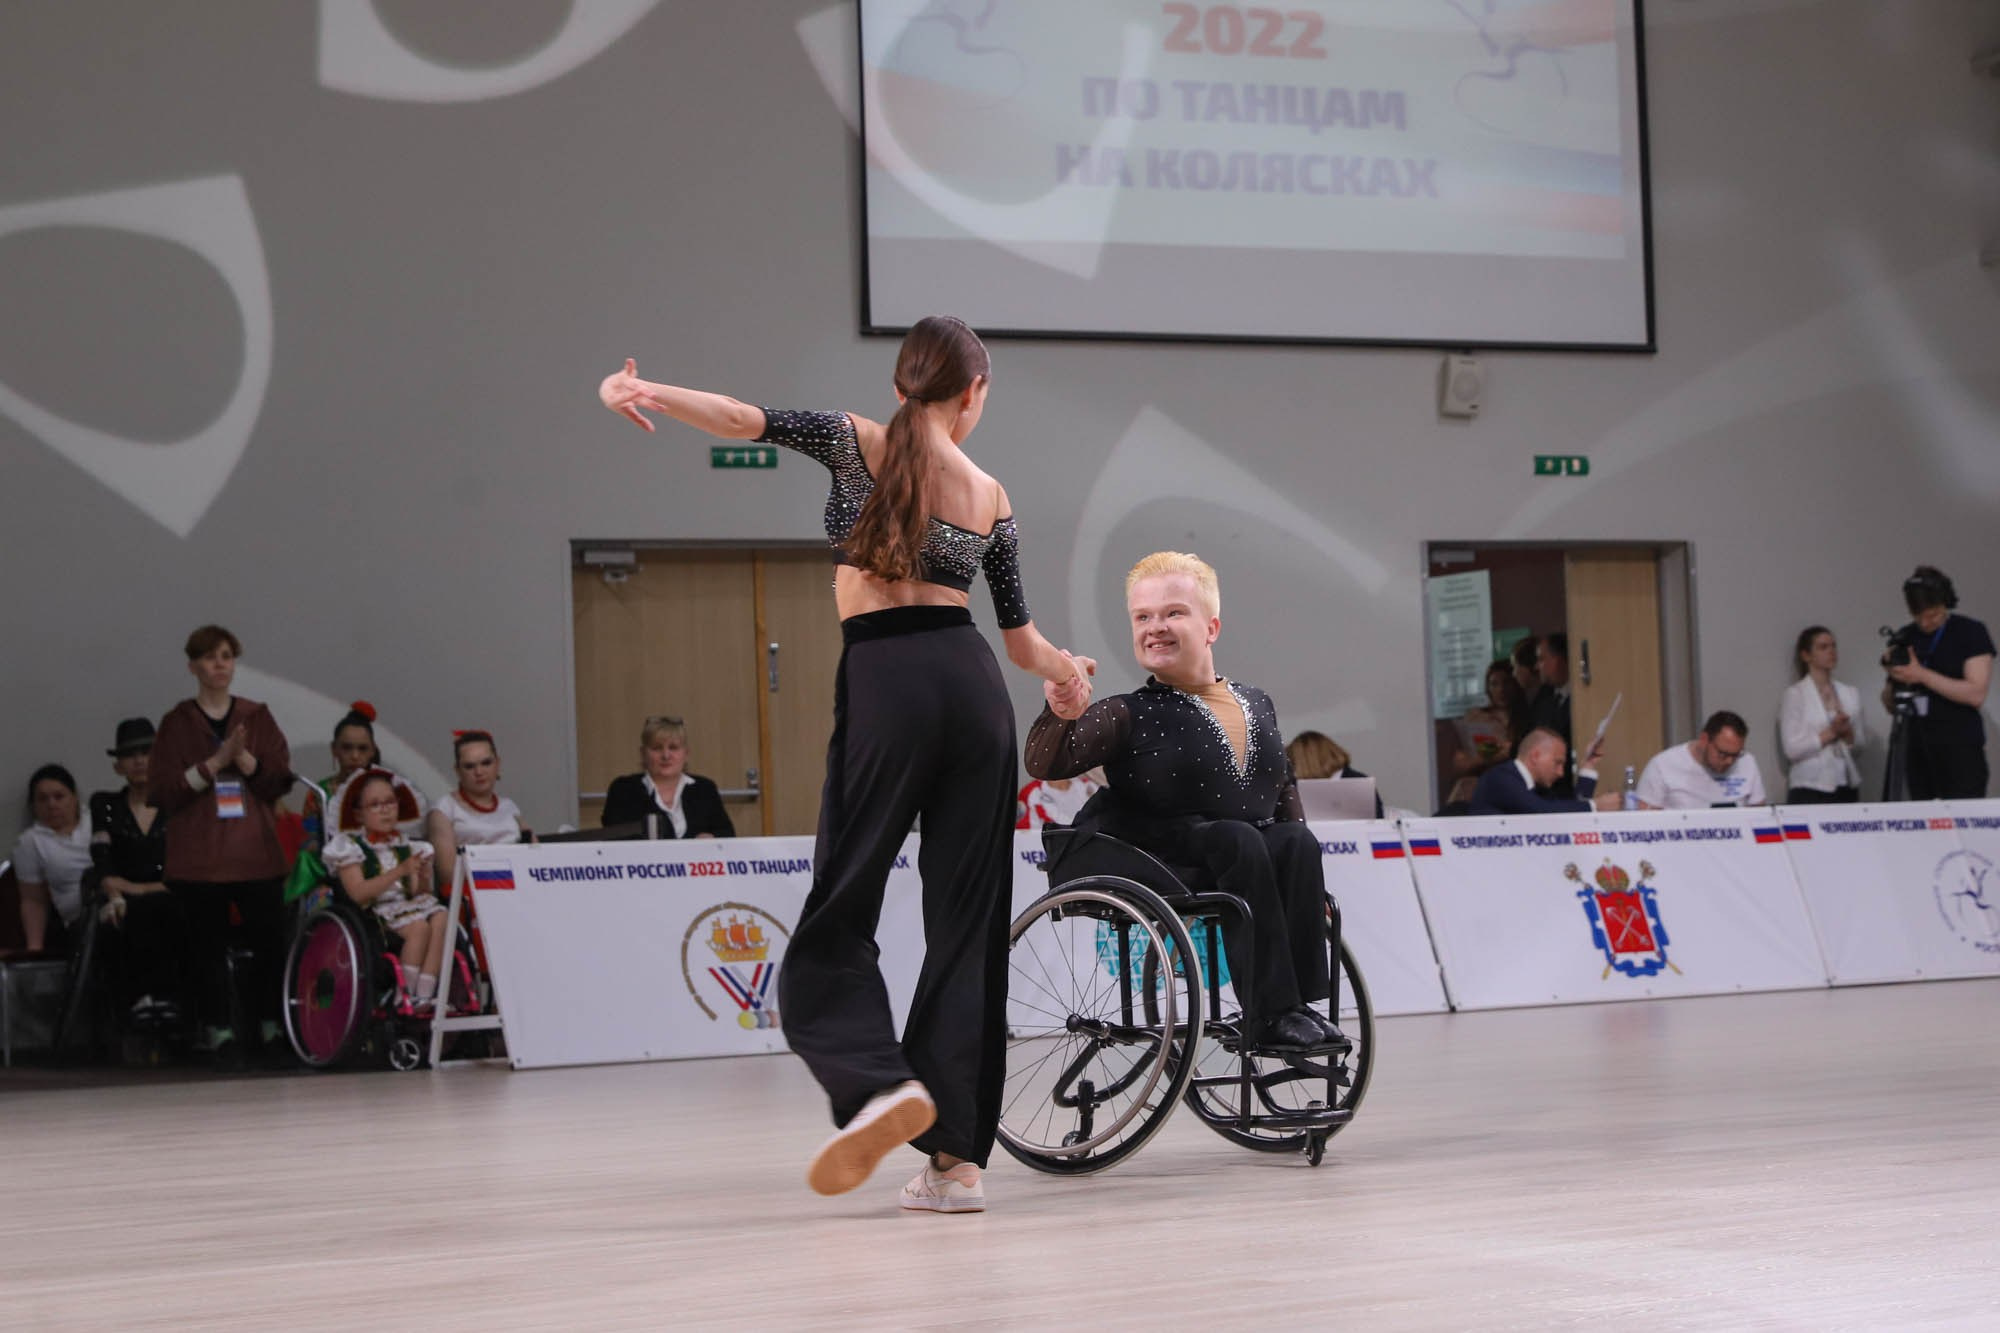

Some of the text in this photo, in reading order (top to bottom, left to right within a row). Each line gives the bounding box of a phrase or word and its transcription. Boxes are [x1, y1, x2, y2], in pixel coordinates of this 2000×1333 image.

[1162, 3, 1328, 60] 2022
[1082, 76, 1407, 135] ПО ТАНЦАМ
[1055, 143, 1438, 198] НА КОЛЯСКАХ
[1451, 827, 1742, 849] ЧЕМПИОНАТ РОССИИ 2022 ПО ТАНЦАМ НА КОЛЯСКАХ
[528, 858, 812, 883] ЧЕМПИОНАТ РОССИИ 2022 ПО ТАНЦАМ
